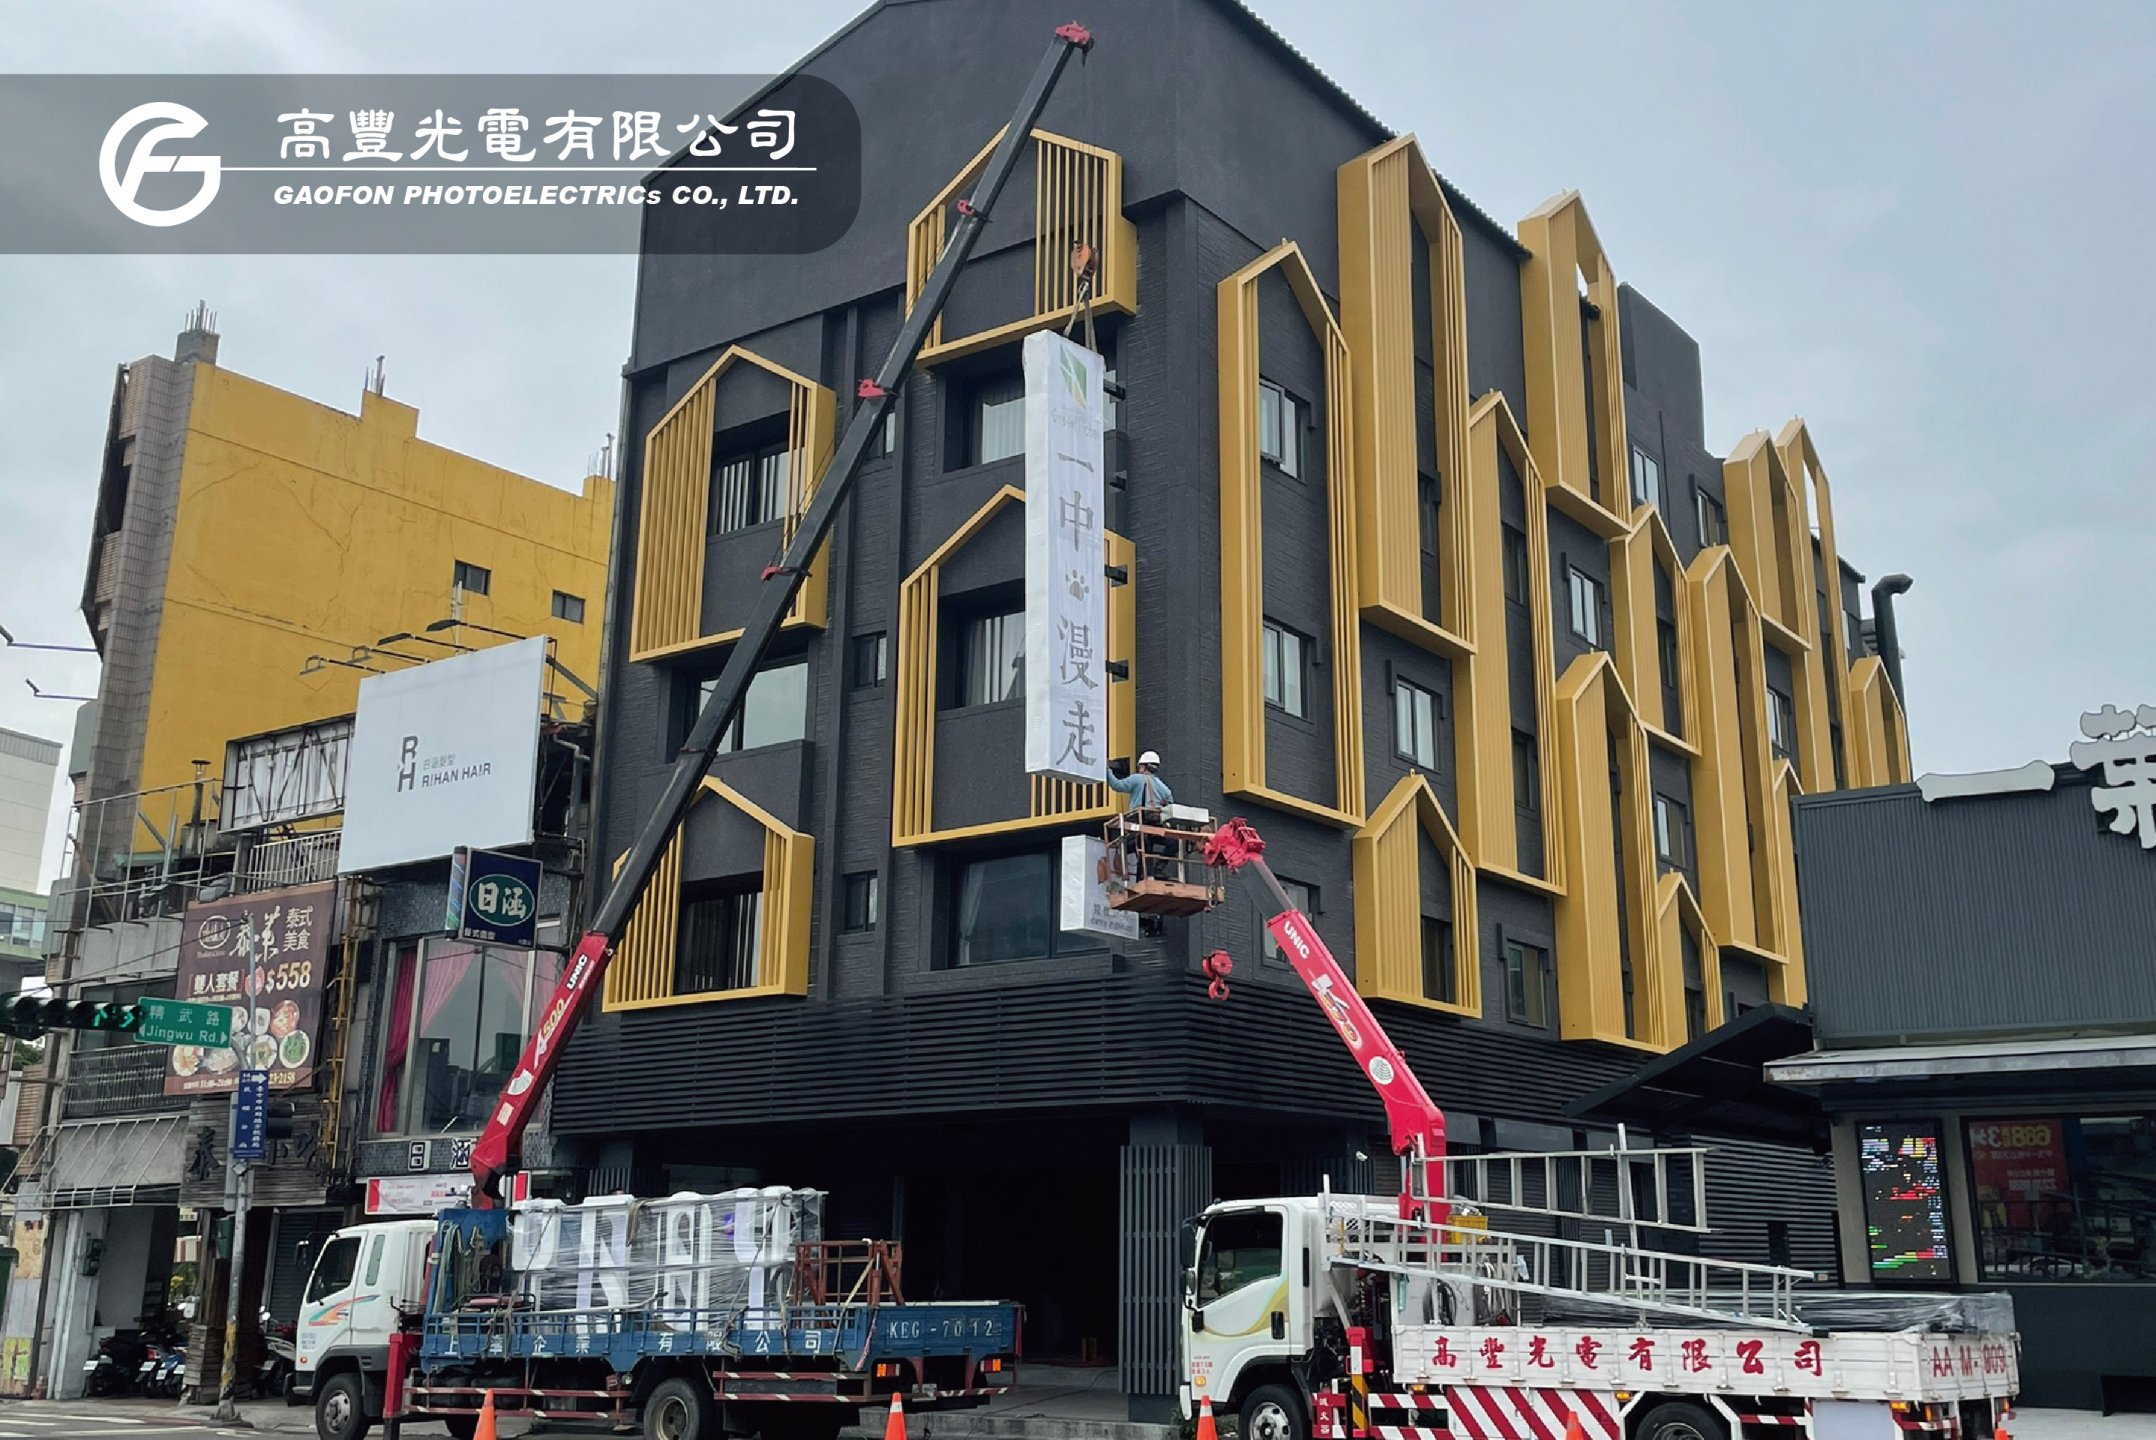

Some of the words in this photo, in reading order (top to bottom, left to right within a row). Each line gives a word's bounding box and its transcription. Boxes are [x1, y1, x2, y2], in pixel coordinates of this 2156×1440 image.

[421, 768, 459, 788] RIHAN
[461, 762, 491, 781] HAIR
[478, 882, 527, 919] 日涵
[285, 906, 313, 928] 泰式
[283, 930, 311, 952] 美食
[1284, 920, 1310, 959] UNIC
[265, 960, 312, 994] $558
[566, 953, 588, 990] UNIC
[150, 1005, 220, 1027] 精武路
[146, 1026, 193, 1042] Jingwu
[199, 1029, 219, 1044] Rd.
[1432, 1335, 1823, 1377] 高豐光電有限公司
